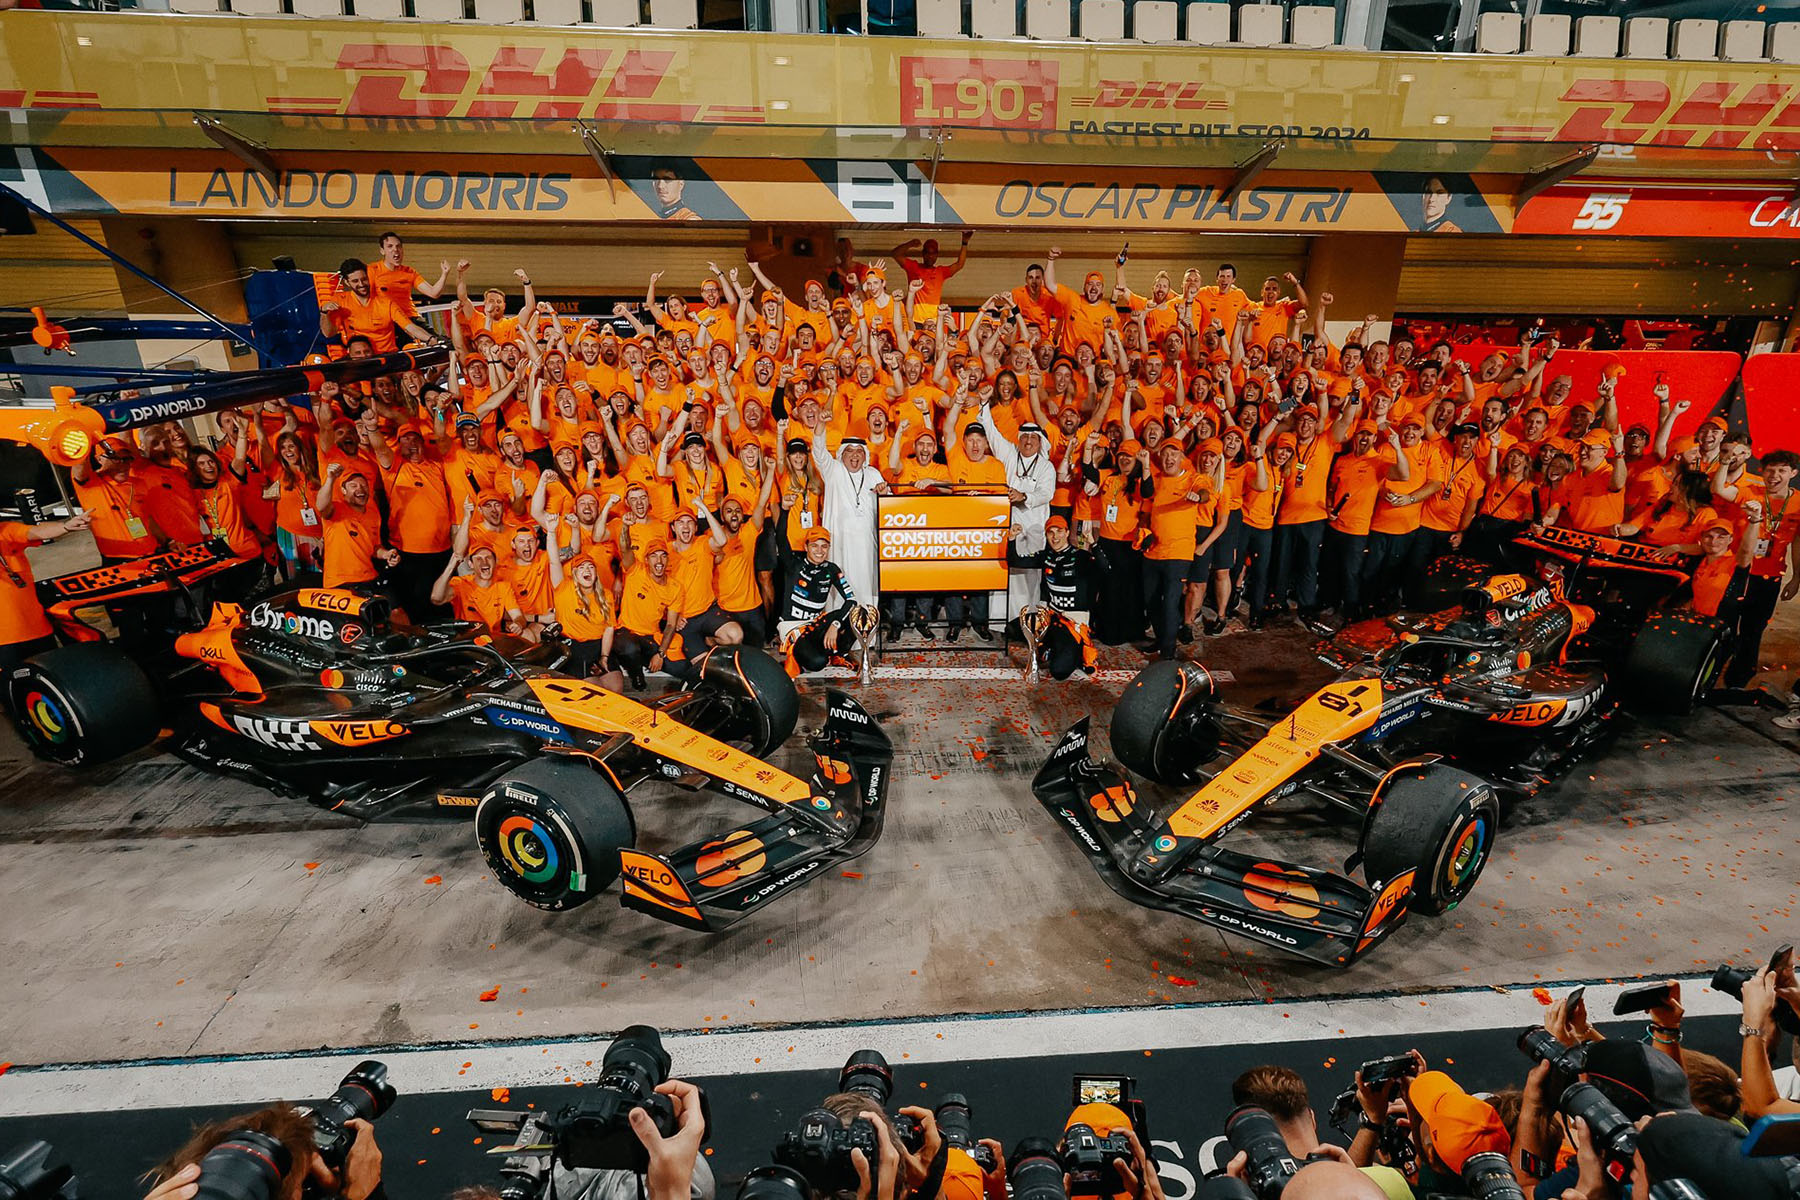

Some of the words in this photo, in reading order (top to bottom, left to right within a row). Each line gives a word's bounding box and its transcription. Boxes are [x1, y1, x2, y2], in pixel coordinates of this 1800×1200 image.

[335, 44, 700, 121] DHL
[1092, 80, 1209, 111] DHL
[169, 167, 358, 210] LANDO
[370, 169, 572, 212] NORRIS
[995, 179, 1168, 220] OSCAR
[1164, 184, 1354, 224] PIASTRI
[1572, 193, 1632, 230] 55
[130, 406, 153, 422] DP
[154, 398, 206, 418] WORLD
[884, 514, 927, 527] 2024
[882, 531, 1007, 545] CONSTRUCTORS'
[1495, 578, 1522, 598] VELO
[310, 592, 350, 611] VELO
[251, 602, 333, 640] Chrome
[200, 646, 226, 660] DELL
[489, 697, 521, 710] RICHARD
[524, 704, 546, 715] MILLE
[830, 707, 868, 724] ARROW
[511, 718, 525, 726] DP
[525, 720, 560, 734] WORLD
[1390, 710, 1416, 727] WORLD
[330, 721, 407, 740] VELO
[1054, 735, 1086, 759] ARROW
[663, 766, 680, 777] FIA
[870, 767, 880, 788] WORLD
[505, 787, 538, 805] PIRELLI
[736, 788, 769, 807] SENNA
[1215, 784, 1239, 799] FxPro
[625, 864, 672, 886] VELO
[758, 884, 777, 896] DP
[776, 861, 819, 886] WORLD
[1378, 885, 1411, 912] VELO
[1219, 914, 1243, 926] DP
[1241, 922, 1297, 945] WORLD
